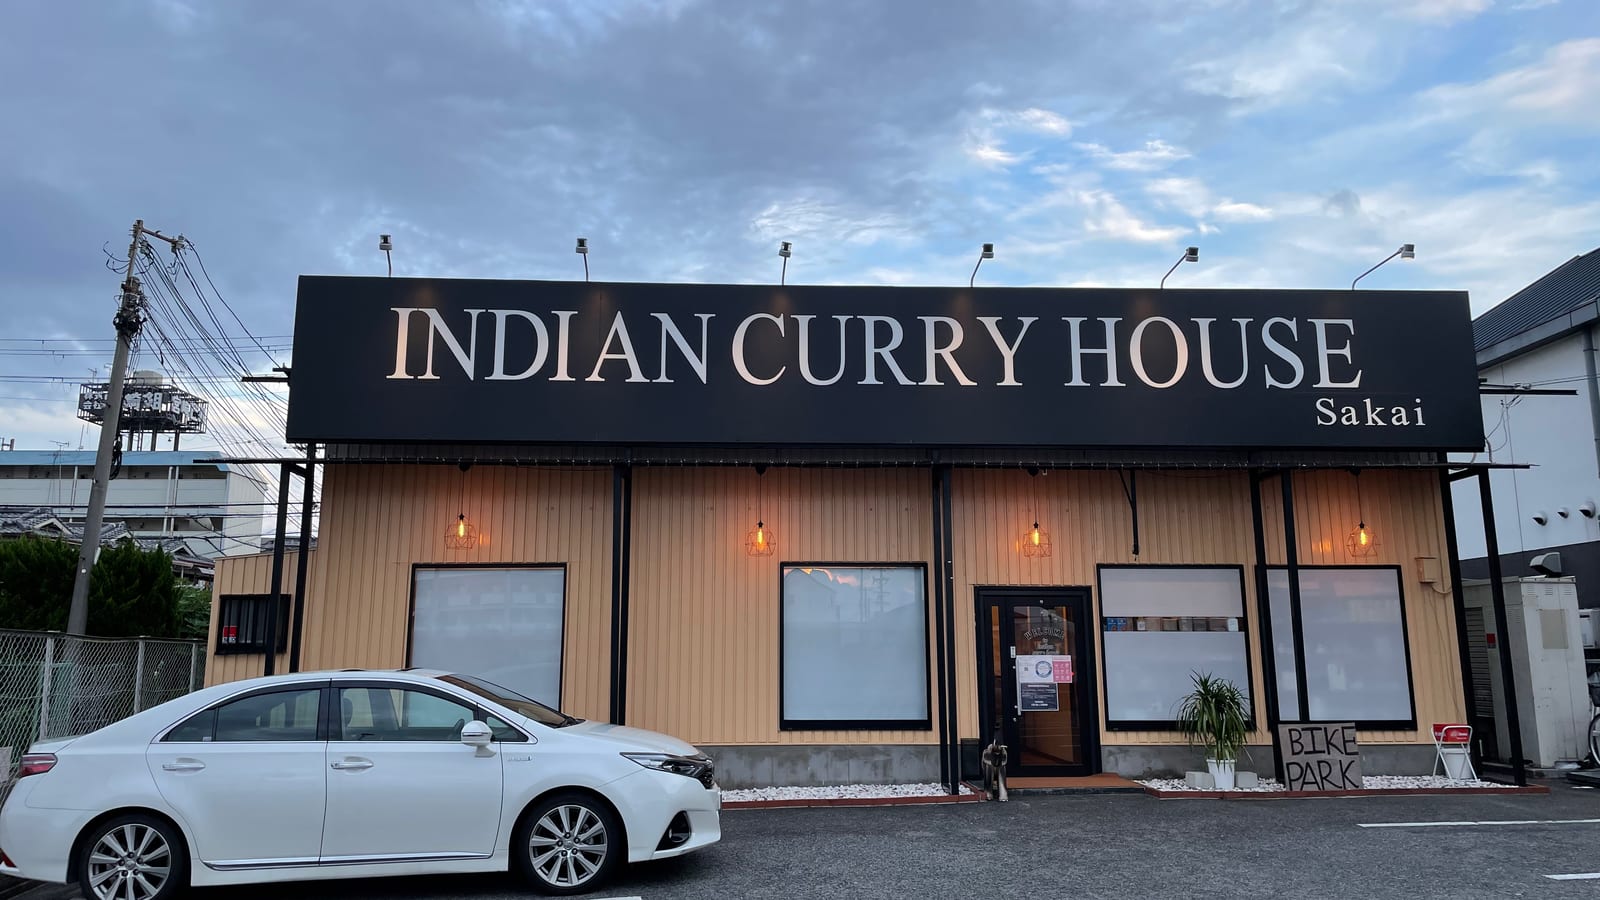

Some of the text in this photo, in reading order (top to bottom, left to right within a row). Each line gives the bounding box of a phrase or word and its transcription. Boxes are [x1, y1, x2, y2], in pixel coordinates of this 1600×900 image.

[386, 307, 1362, 389] INDIAN CURRY HOUSE
[1315, 397, 1426, 426] Sakai
[1288, 726, 1360, 756] BIKE
[1286, 759, 1360, 791] PARK
